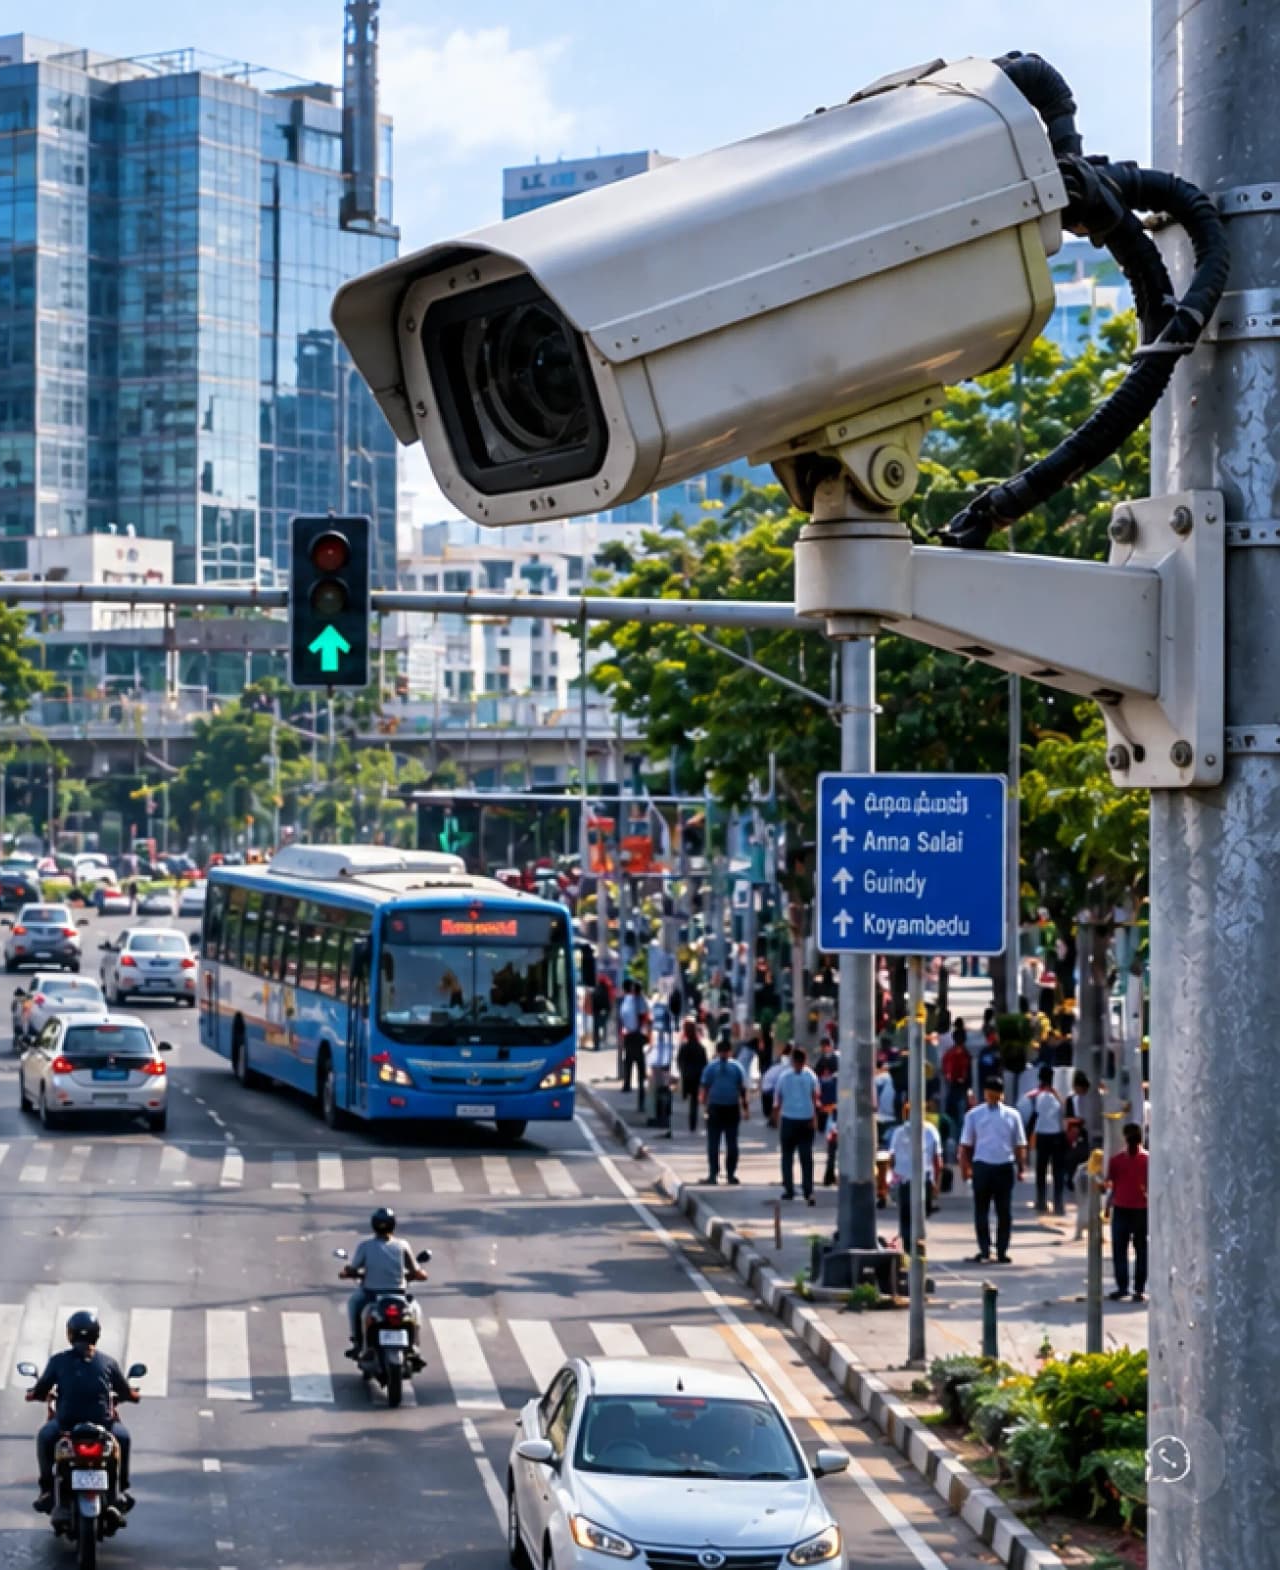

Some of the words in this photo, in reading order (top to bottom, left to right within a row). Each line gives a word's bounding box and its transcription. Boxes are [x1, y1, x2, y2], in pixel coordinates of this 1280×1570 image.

[863, 829, 910, 852] Anna
[864, 868, 927, 899] Guindy
[864, 912, 970, 941] Koyambedu
